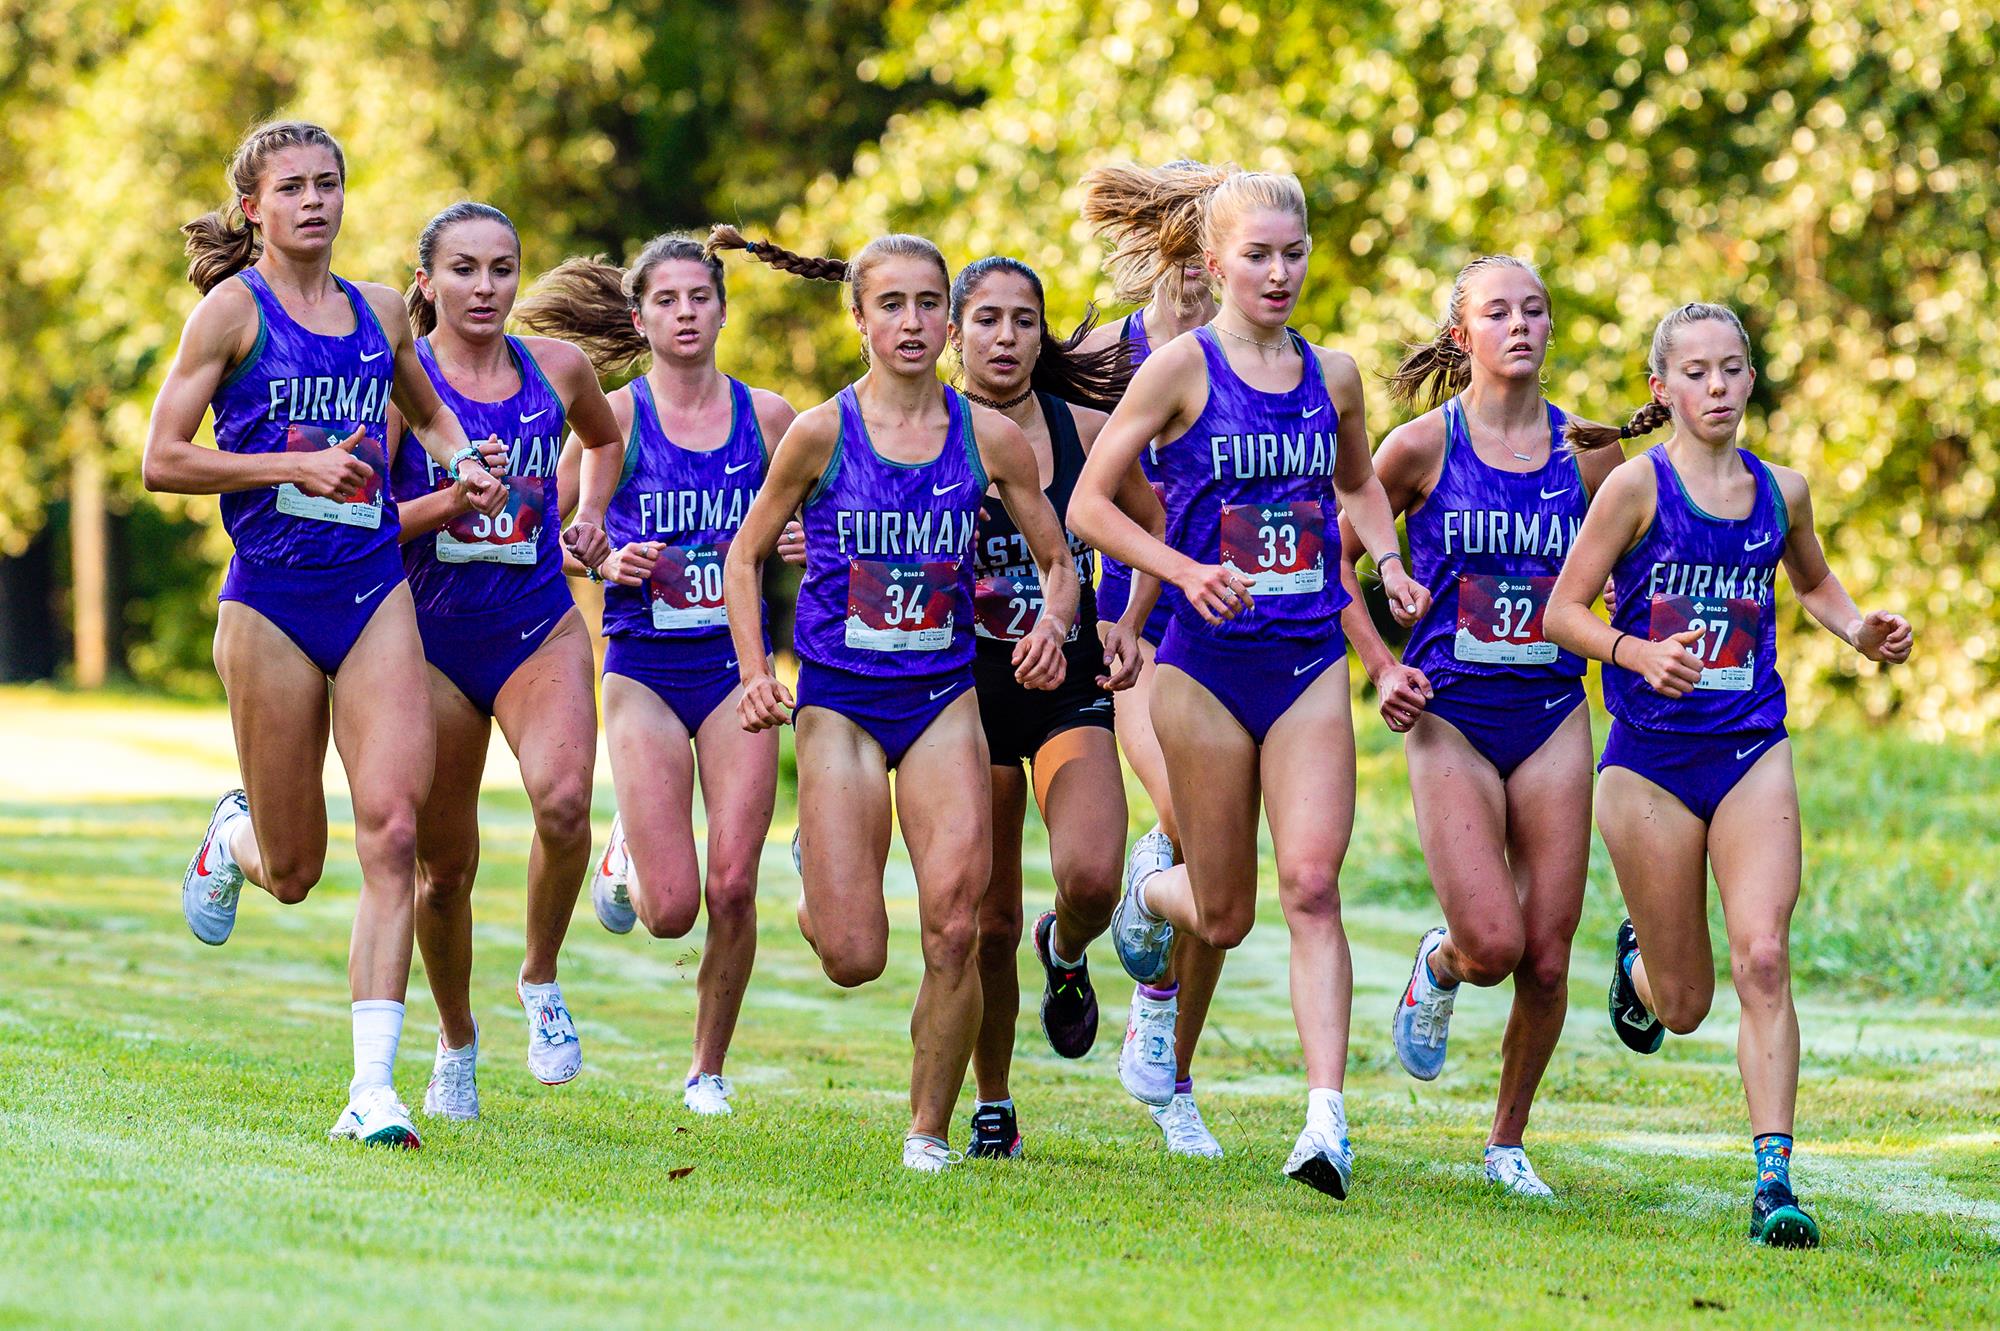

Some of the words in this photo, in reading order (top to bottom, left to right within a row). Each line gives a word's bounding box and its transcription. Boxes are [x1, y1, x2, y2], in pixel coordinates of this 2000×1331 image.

[268, 376, 393, 422] FURMAN
[1211, 432, 1337, 480] FURMAN
[837, 510, 975, 555] FURMAN
[1257, 524, 1297, 568] 33
[684, 563, 723, 604] 30
[884, 584, 925, 626] 34
[1006, 597, 1045, 636] 27
[1492, 597, 1533, 638] 32
[1685, 618, 1729, 662] 37
